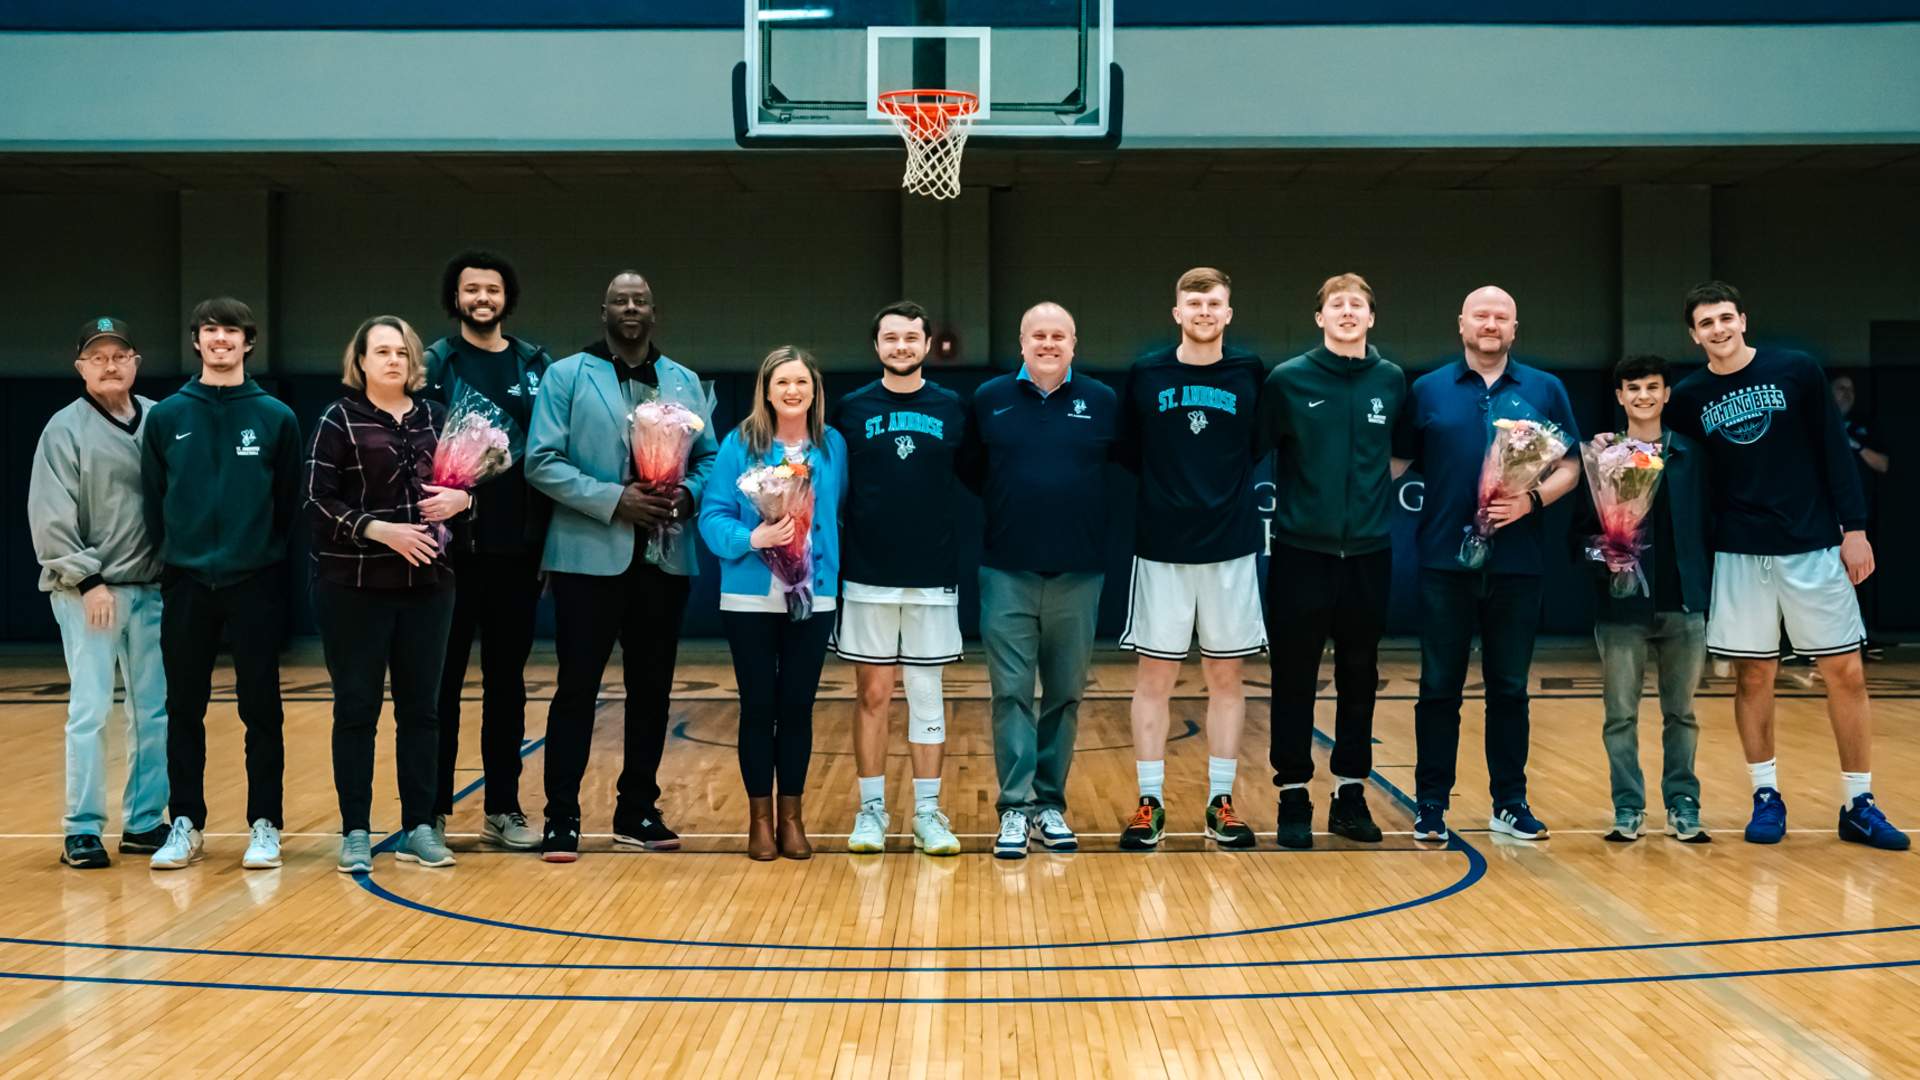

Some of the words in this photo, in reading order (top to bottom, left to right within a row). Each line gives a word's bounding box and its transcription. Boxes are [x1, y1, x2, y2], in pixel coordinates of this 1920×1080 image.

[1158, 387, 1178, 412] ST.
[1181, 385, 1236, 415] AMBROSE
[1722, 384, 1776, 401] AMBROSE
[865, 415, 885, 439] ST.
[888, 411, 943, 440] AMBROSE
[1701, 393, 1750, 434] FIGHTING
[1751, 390, 1786, 411] BEES
[1725, 411, 1764, 428] BASKETBALL
